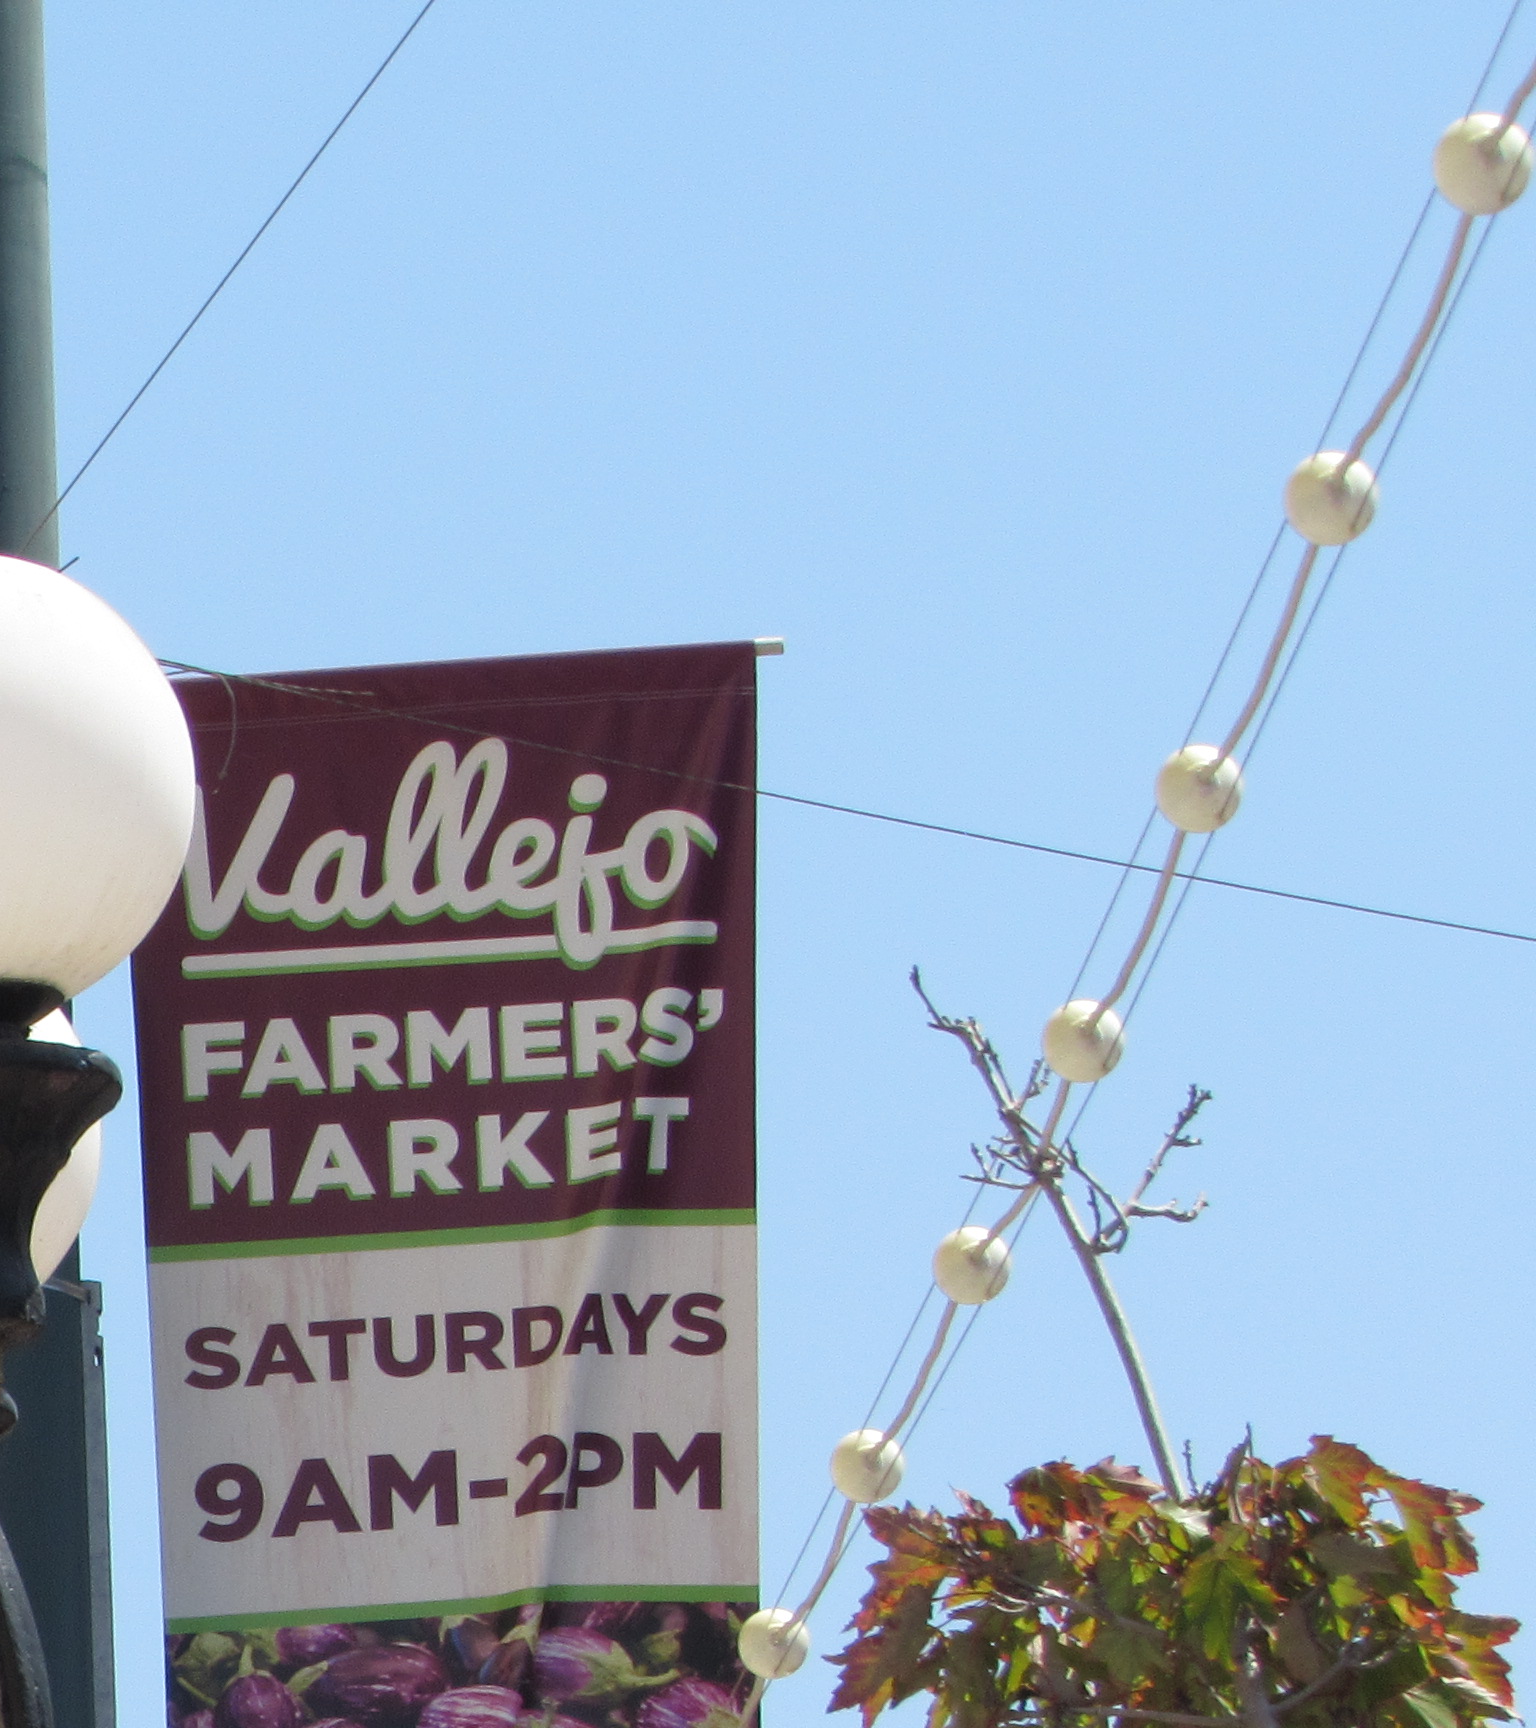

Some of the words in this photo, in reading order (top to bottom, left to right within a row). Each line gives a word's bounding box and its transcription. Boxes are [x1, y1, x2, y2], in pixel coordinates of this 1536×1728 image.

[182, 736, 718, 970] Vallejo
[181, 986, 724, 1101] FARMERS'
[186, 1096, 690, 1210] MARKET
[184, 1292, 728, 1391] SATURDAYS
[193, 1431, 723, 1544] 9AM-2PM
